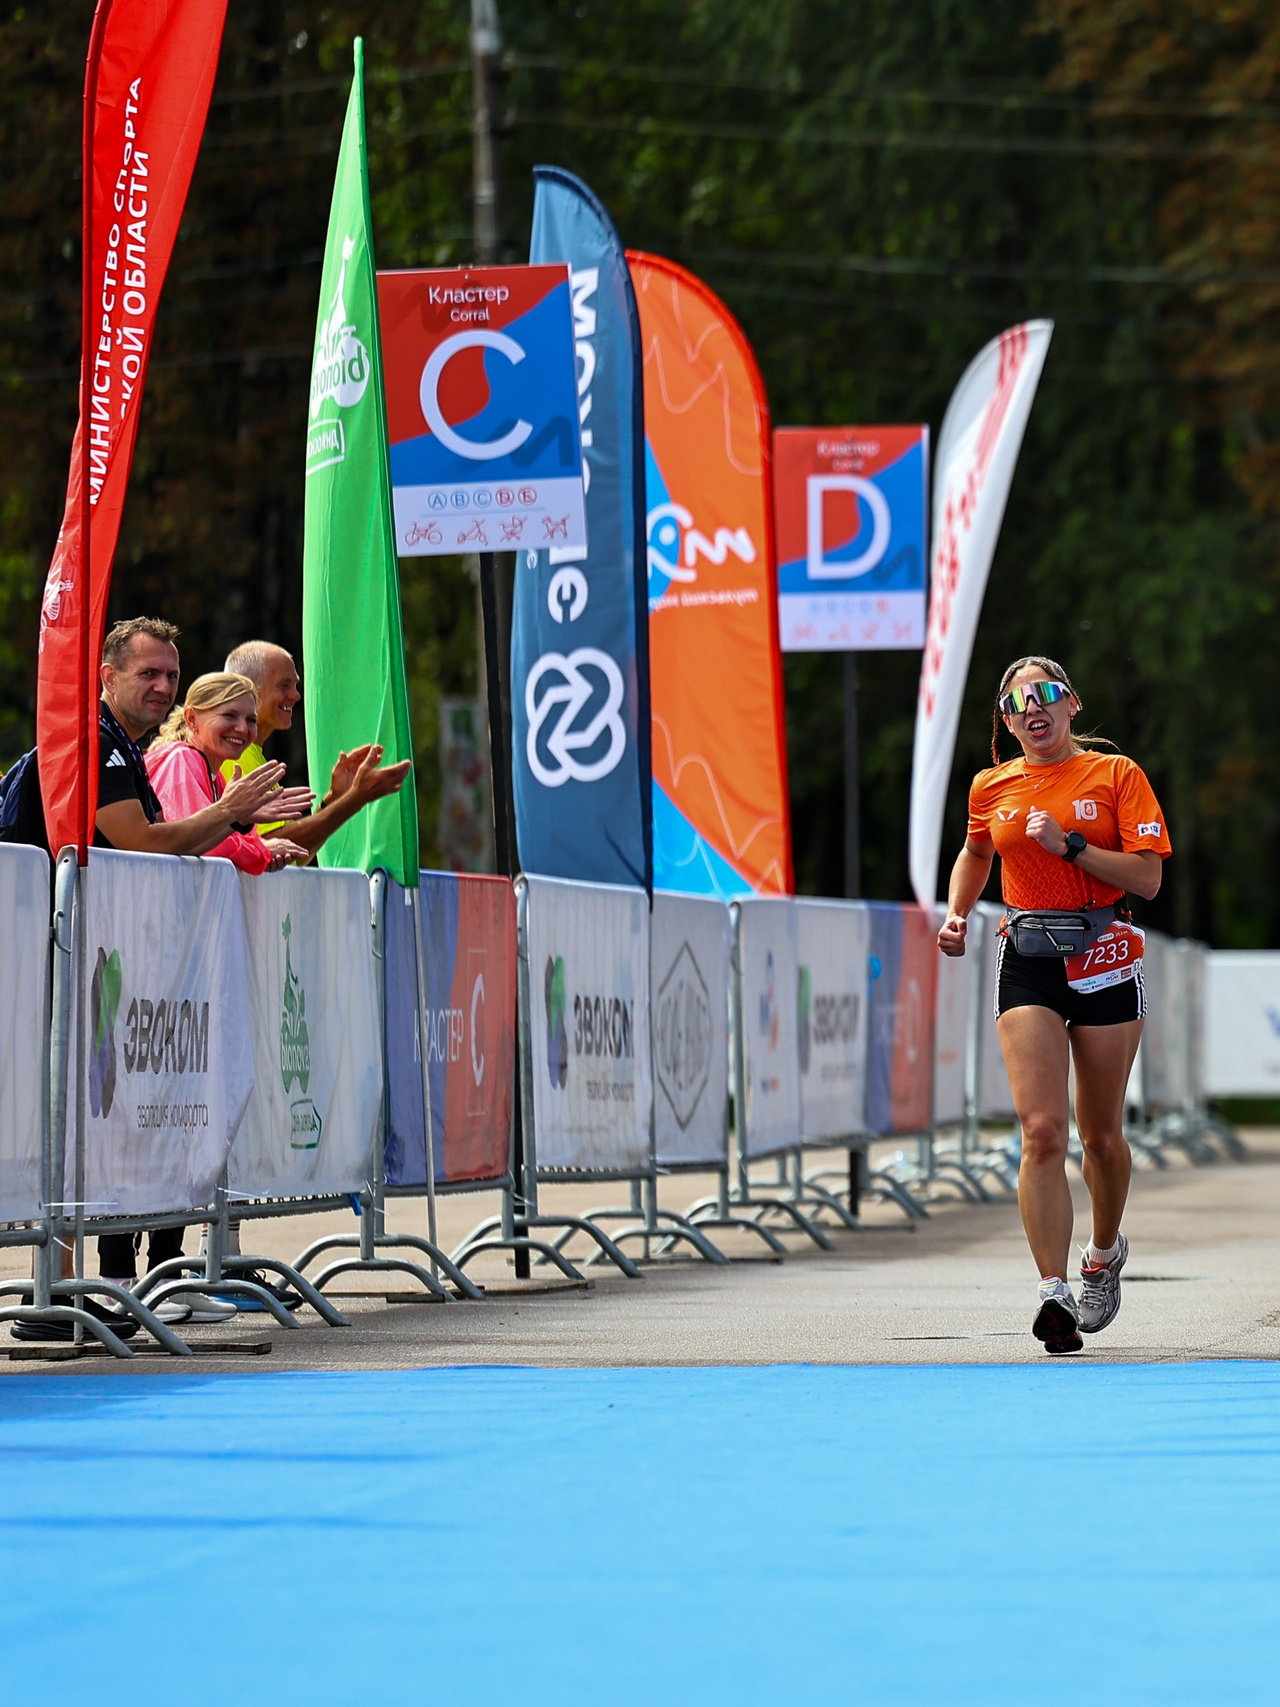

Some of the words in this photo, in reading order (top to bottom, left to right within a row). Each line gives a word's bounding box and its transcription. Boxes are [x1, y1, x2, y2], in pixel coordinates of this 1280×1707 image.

[123, 151, 149, 315] ОБЛАСТИ
[89, 223, 121, 505] МИНИСТЕРСТВО
[114, 77, 142, 213] СПОРТА
[428, 285, 509, 305] Кластер
[450, 308, 490, 322] Corral
[807, 474, 891, 581] D
[1072, 798, 1098, 821] 10
[1083, 940, 1129, 971] 7233
[124, 997, 209, 1074] ЭВОКОМ
